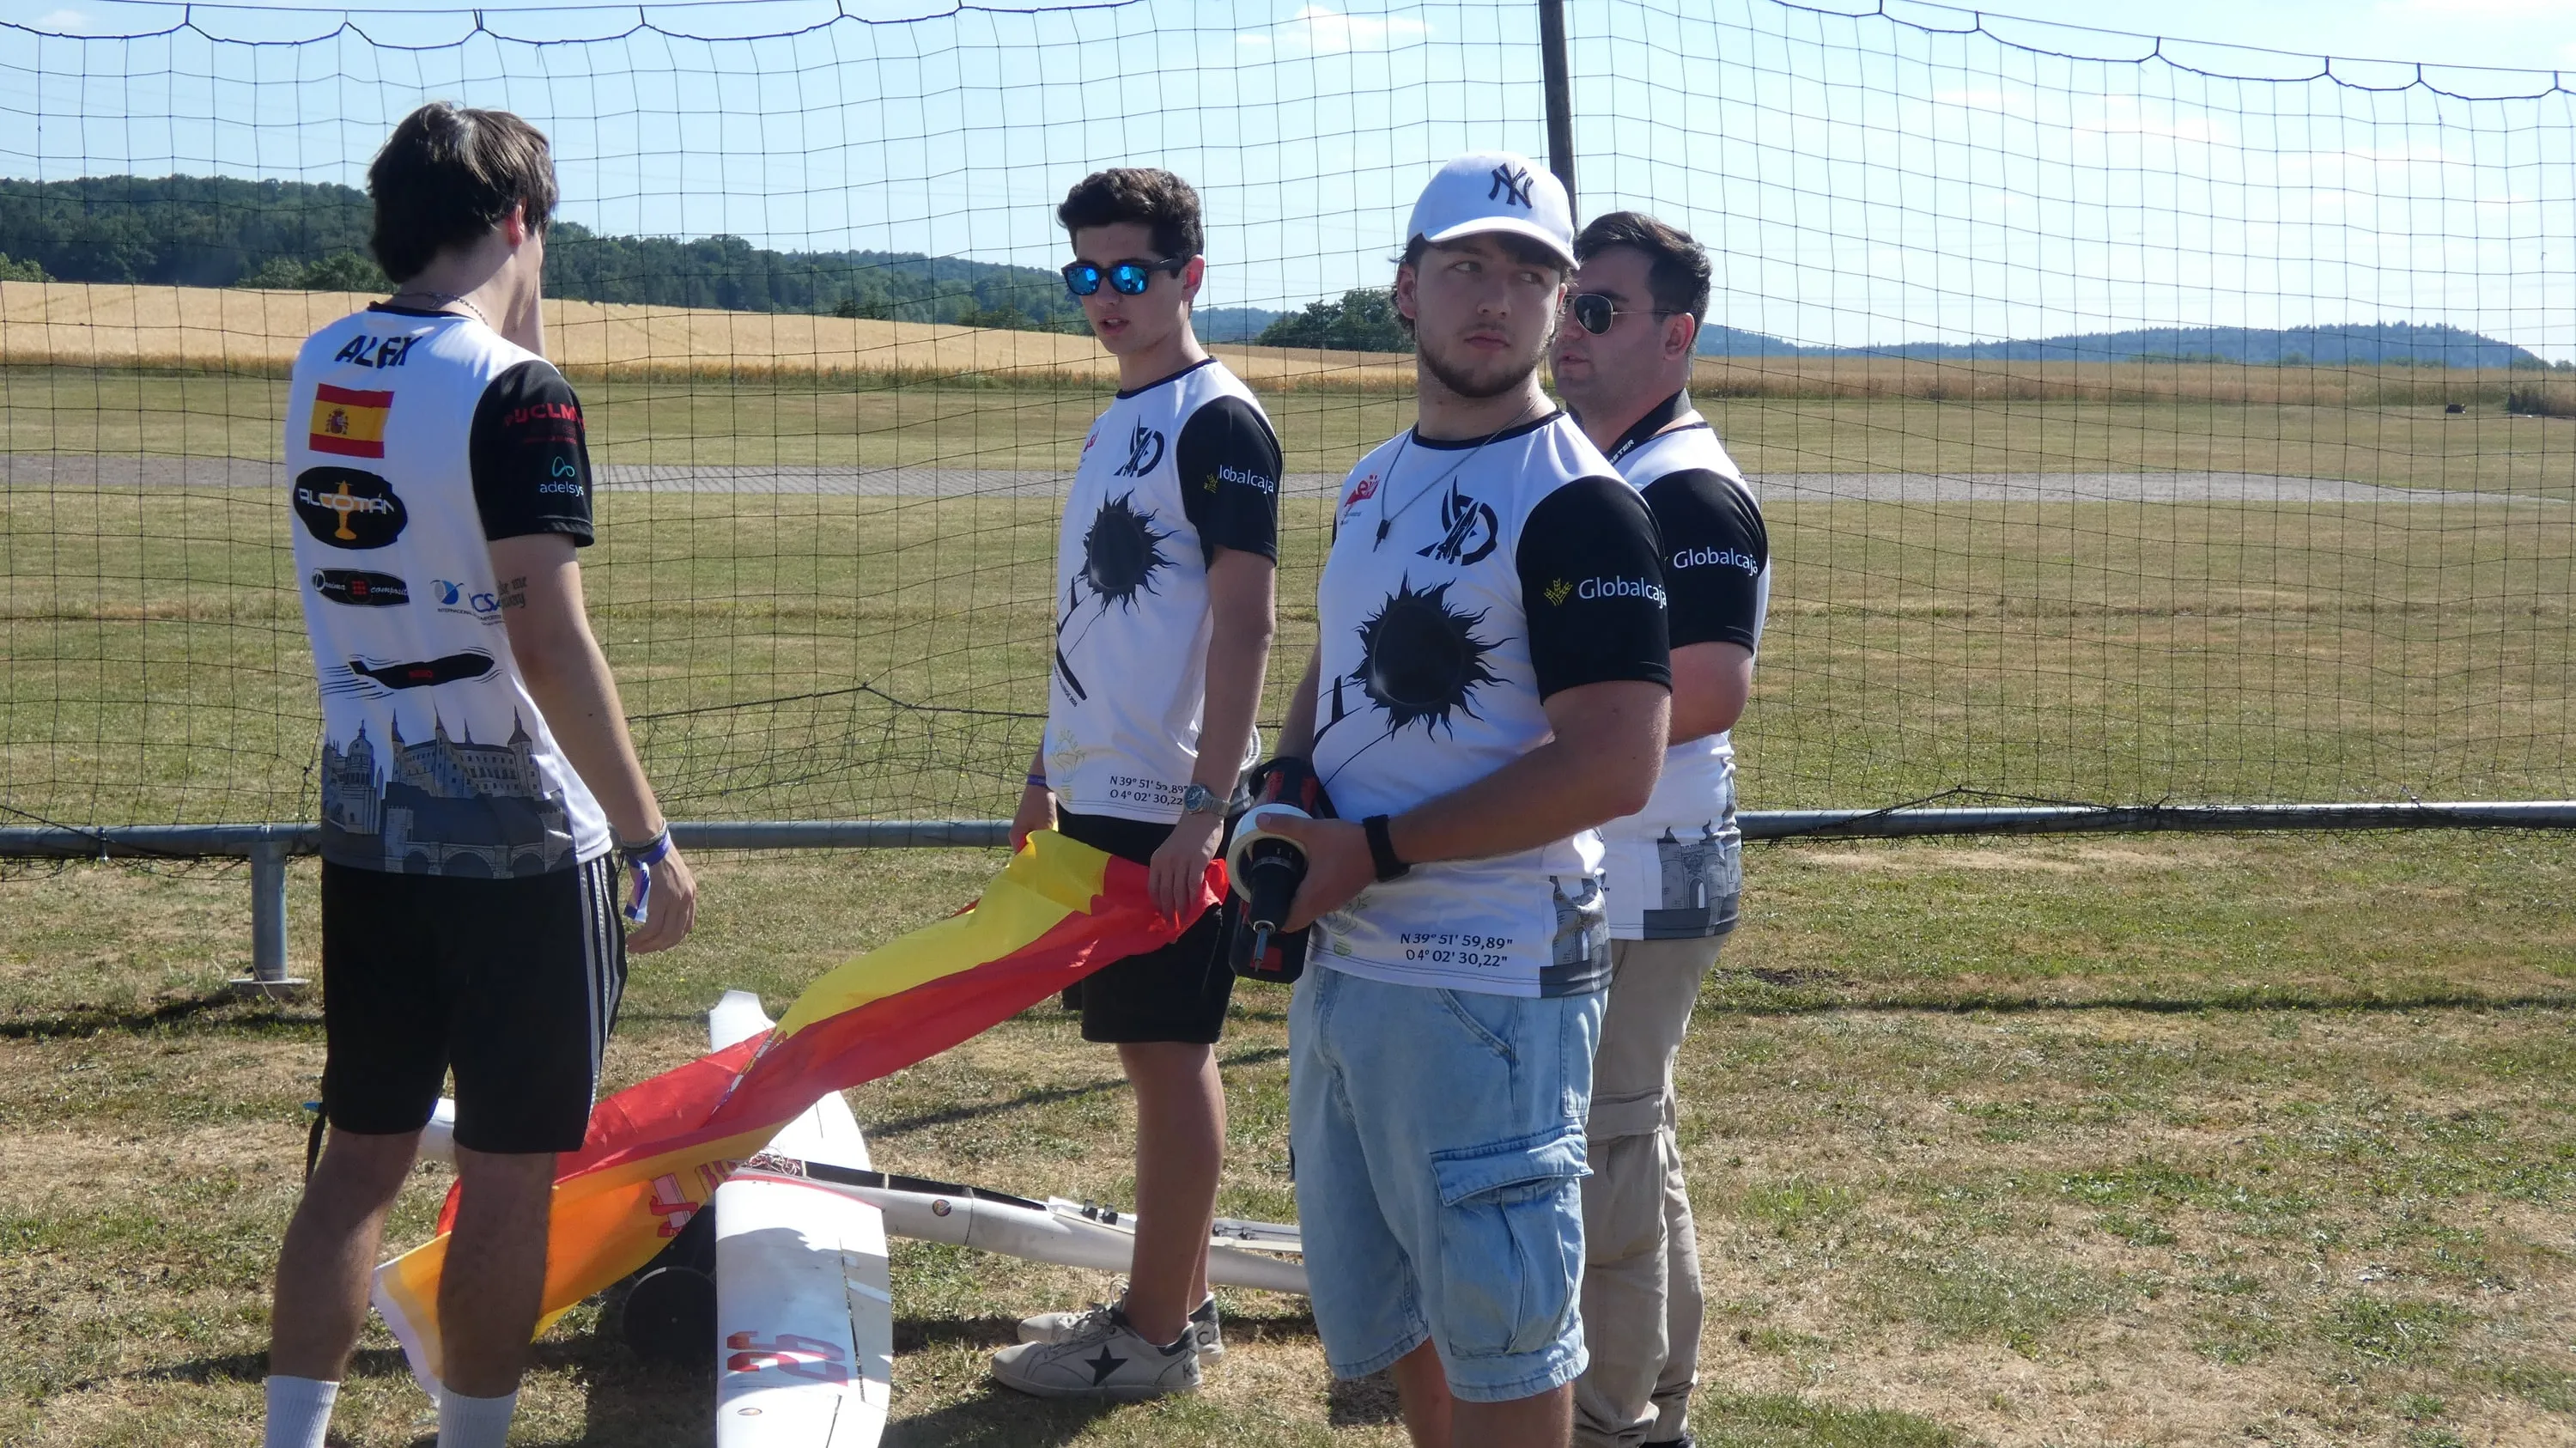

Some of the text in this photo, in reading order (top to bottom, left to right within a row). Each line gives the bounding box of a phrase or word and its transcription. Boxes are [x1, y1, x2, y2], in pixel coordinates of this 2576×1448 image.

[334, 334, 422, 369] ALEX
[1219, 464, 1274, 494] lobalcaja
[1674, 546, 1759, 576] Globalcaja
[1578, 575, 1668, 609] Globalcaja
[1109, 776, 1118, 785] N
[1400, 933, 1411, 945] N
[1438, 934, 1459, 946] 51'
[1461, 934, 1514, 950] 59,89"
[1432, 950, 1455, 963] 02'
[1458, 952, 1508, 968] 30,22"
